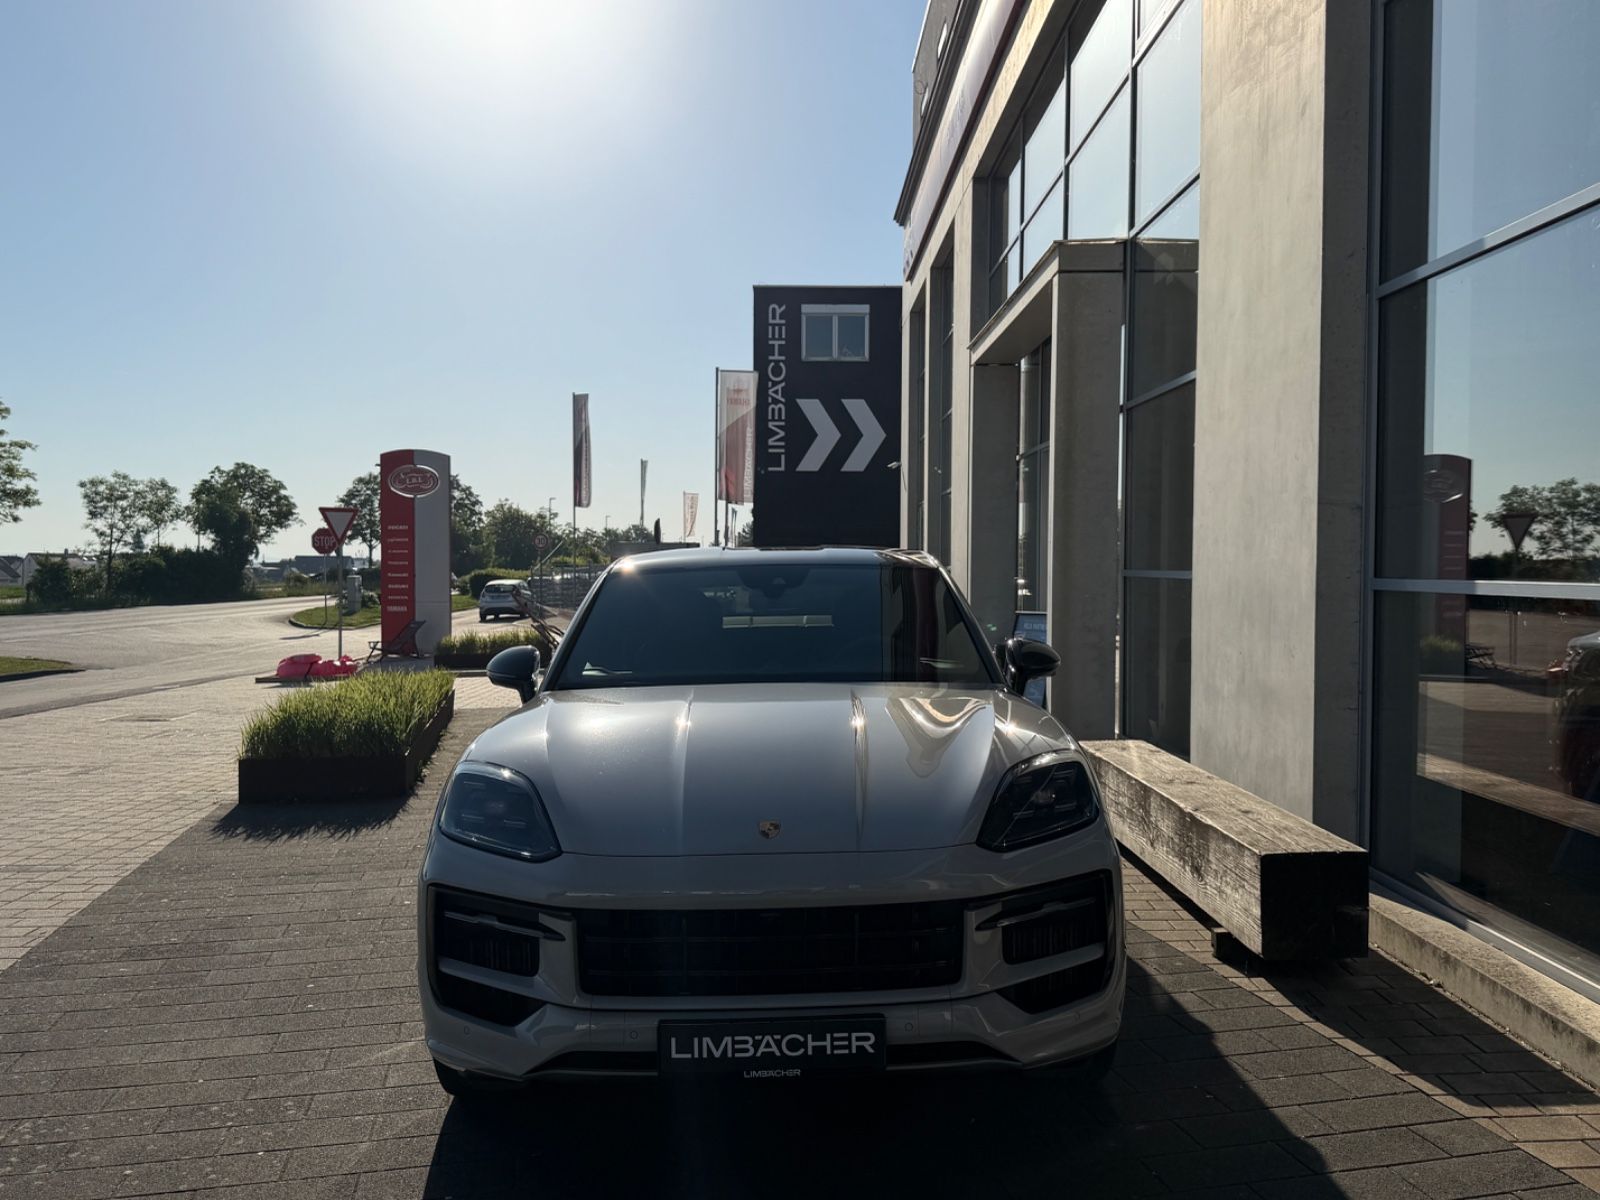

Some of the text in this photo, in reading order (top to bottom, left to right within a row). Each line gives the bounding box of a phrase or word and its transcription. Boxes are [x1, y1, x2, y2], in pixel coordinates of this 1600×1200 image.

[768, 303, 786, 472] LIMBÄCHER
[314, 536, 336, 547] STOP
[670, 1032, 876, 1059] LIMBÄCHER
